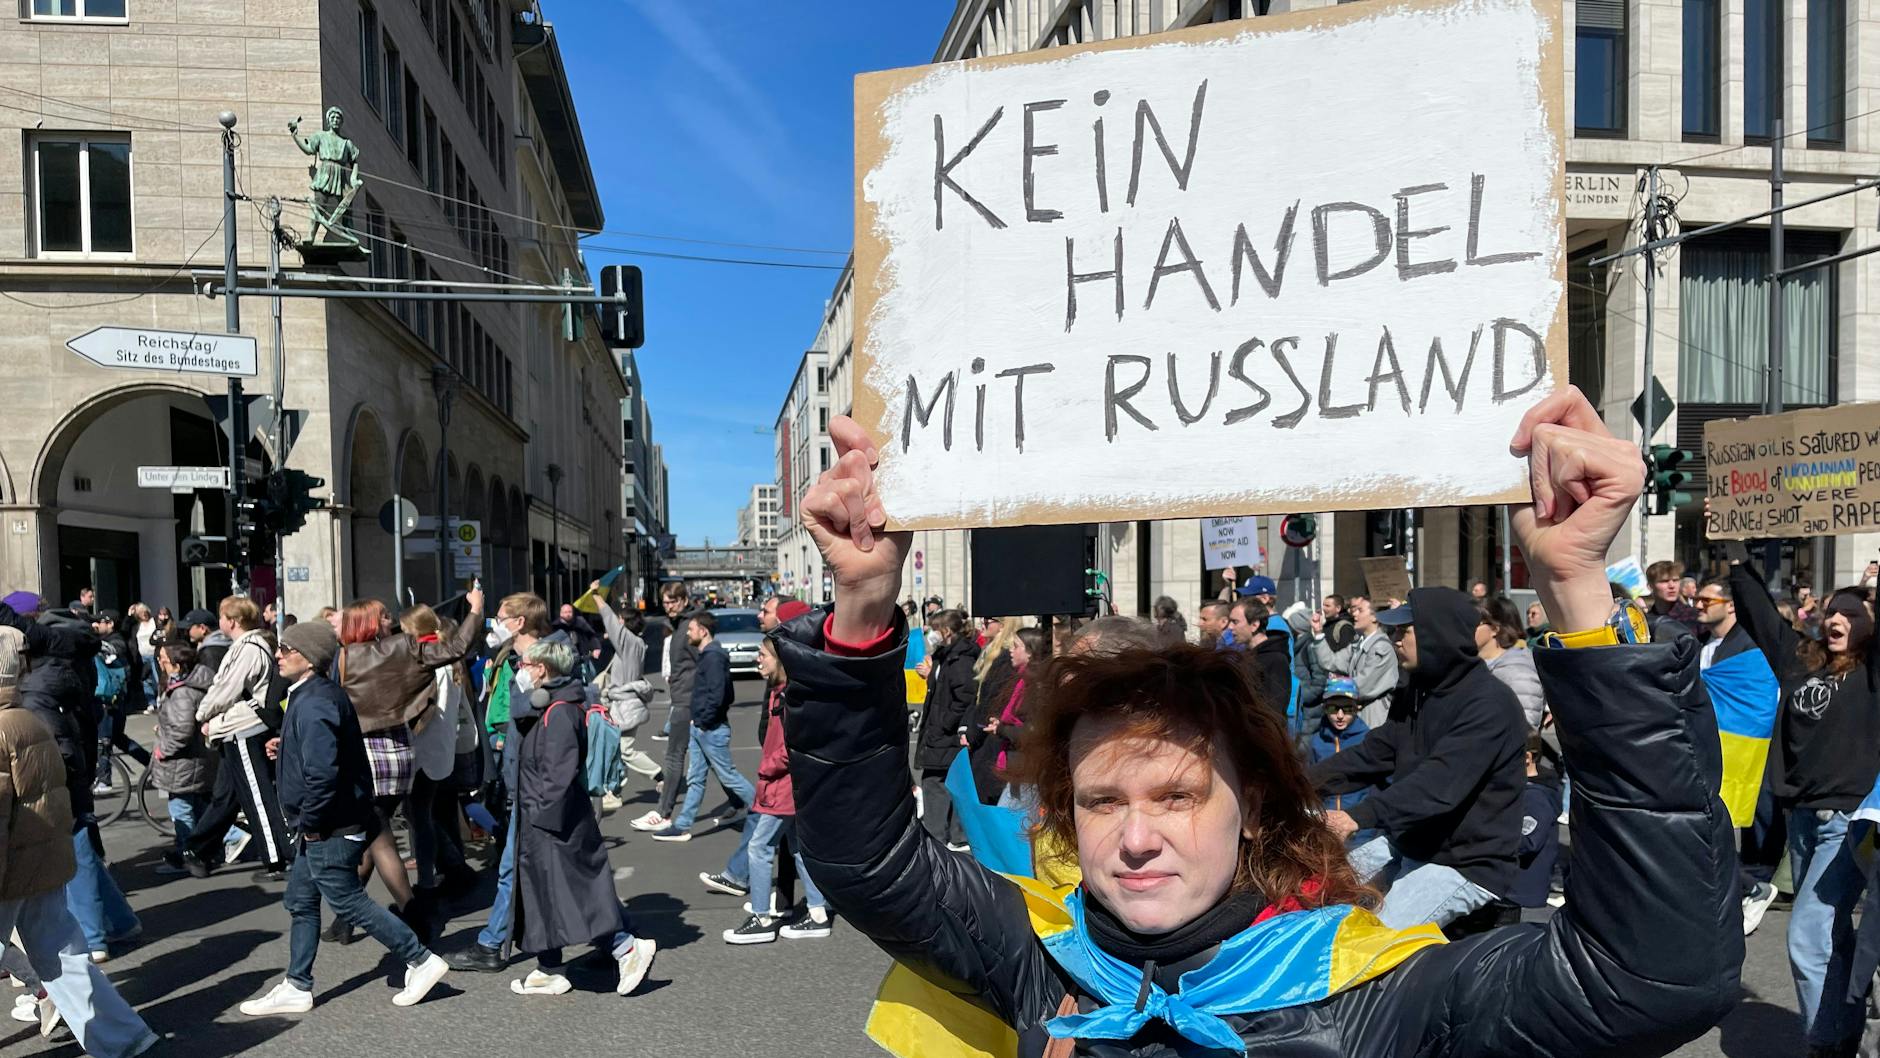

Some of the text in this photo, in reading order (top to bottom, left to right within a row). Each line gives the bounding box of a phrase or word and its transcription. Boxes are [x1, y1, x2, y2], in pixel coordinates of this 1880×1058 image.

[1576, 194, 1618, 203] LINDEN
[1065, 172, 1543, 333] HANDEL
[116, 350, 241, 371] Sitz des Bundestages
[1105, 318, 1547, 443] RUSSLAND
[145, 471, 169, 481] Unter
[1771, 466, 1783, 491] of
[1784, 458, 1857, 491] UKRAINIAN
[1735, 487, 1860, 507] WHO WERE
[1767, 505, 1802, 526] SHOT
[1219, 528, 1233, 536] NOW
[1237, 536, 1249, 546] AID
[1221, 551, 1236, 560] NOW
